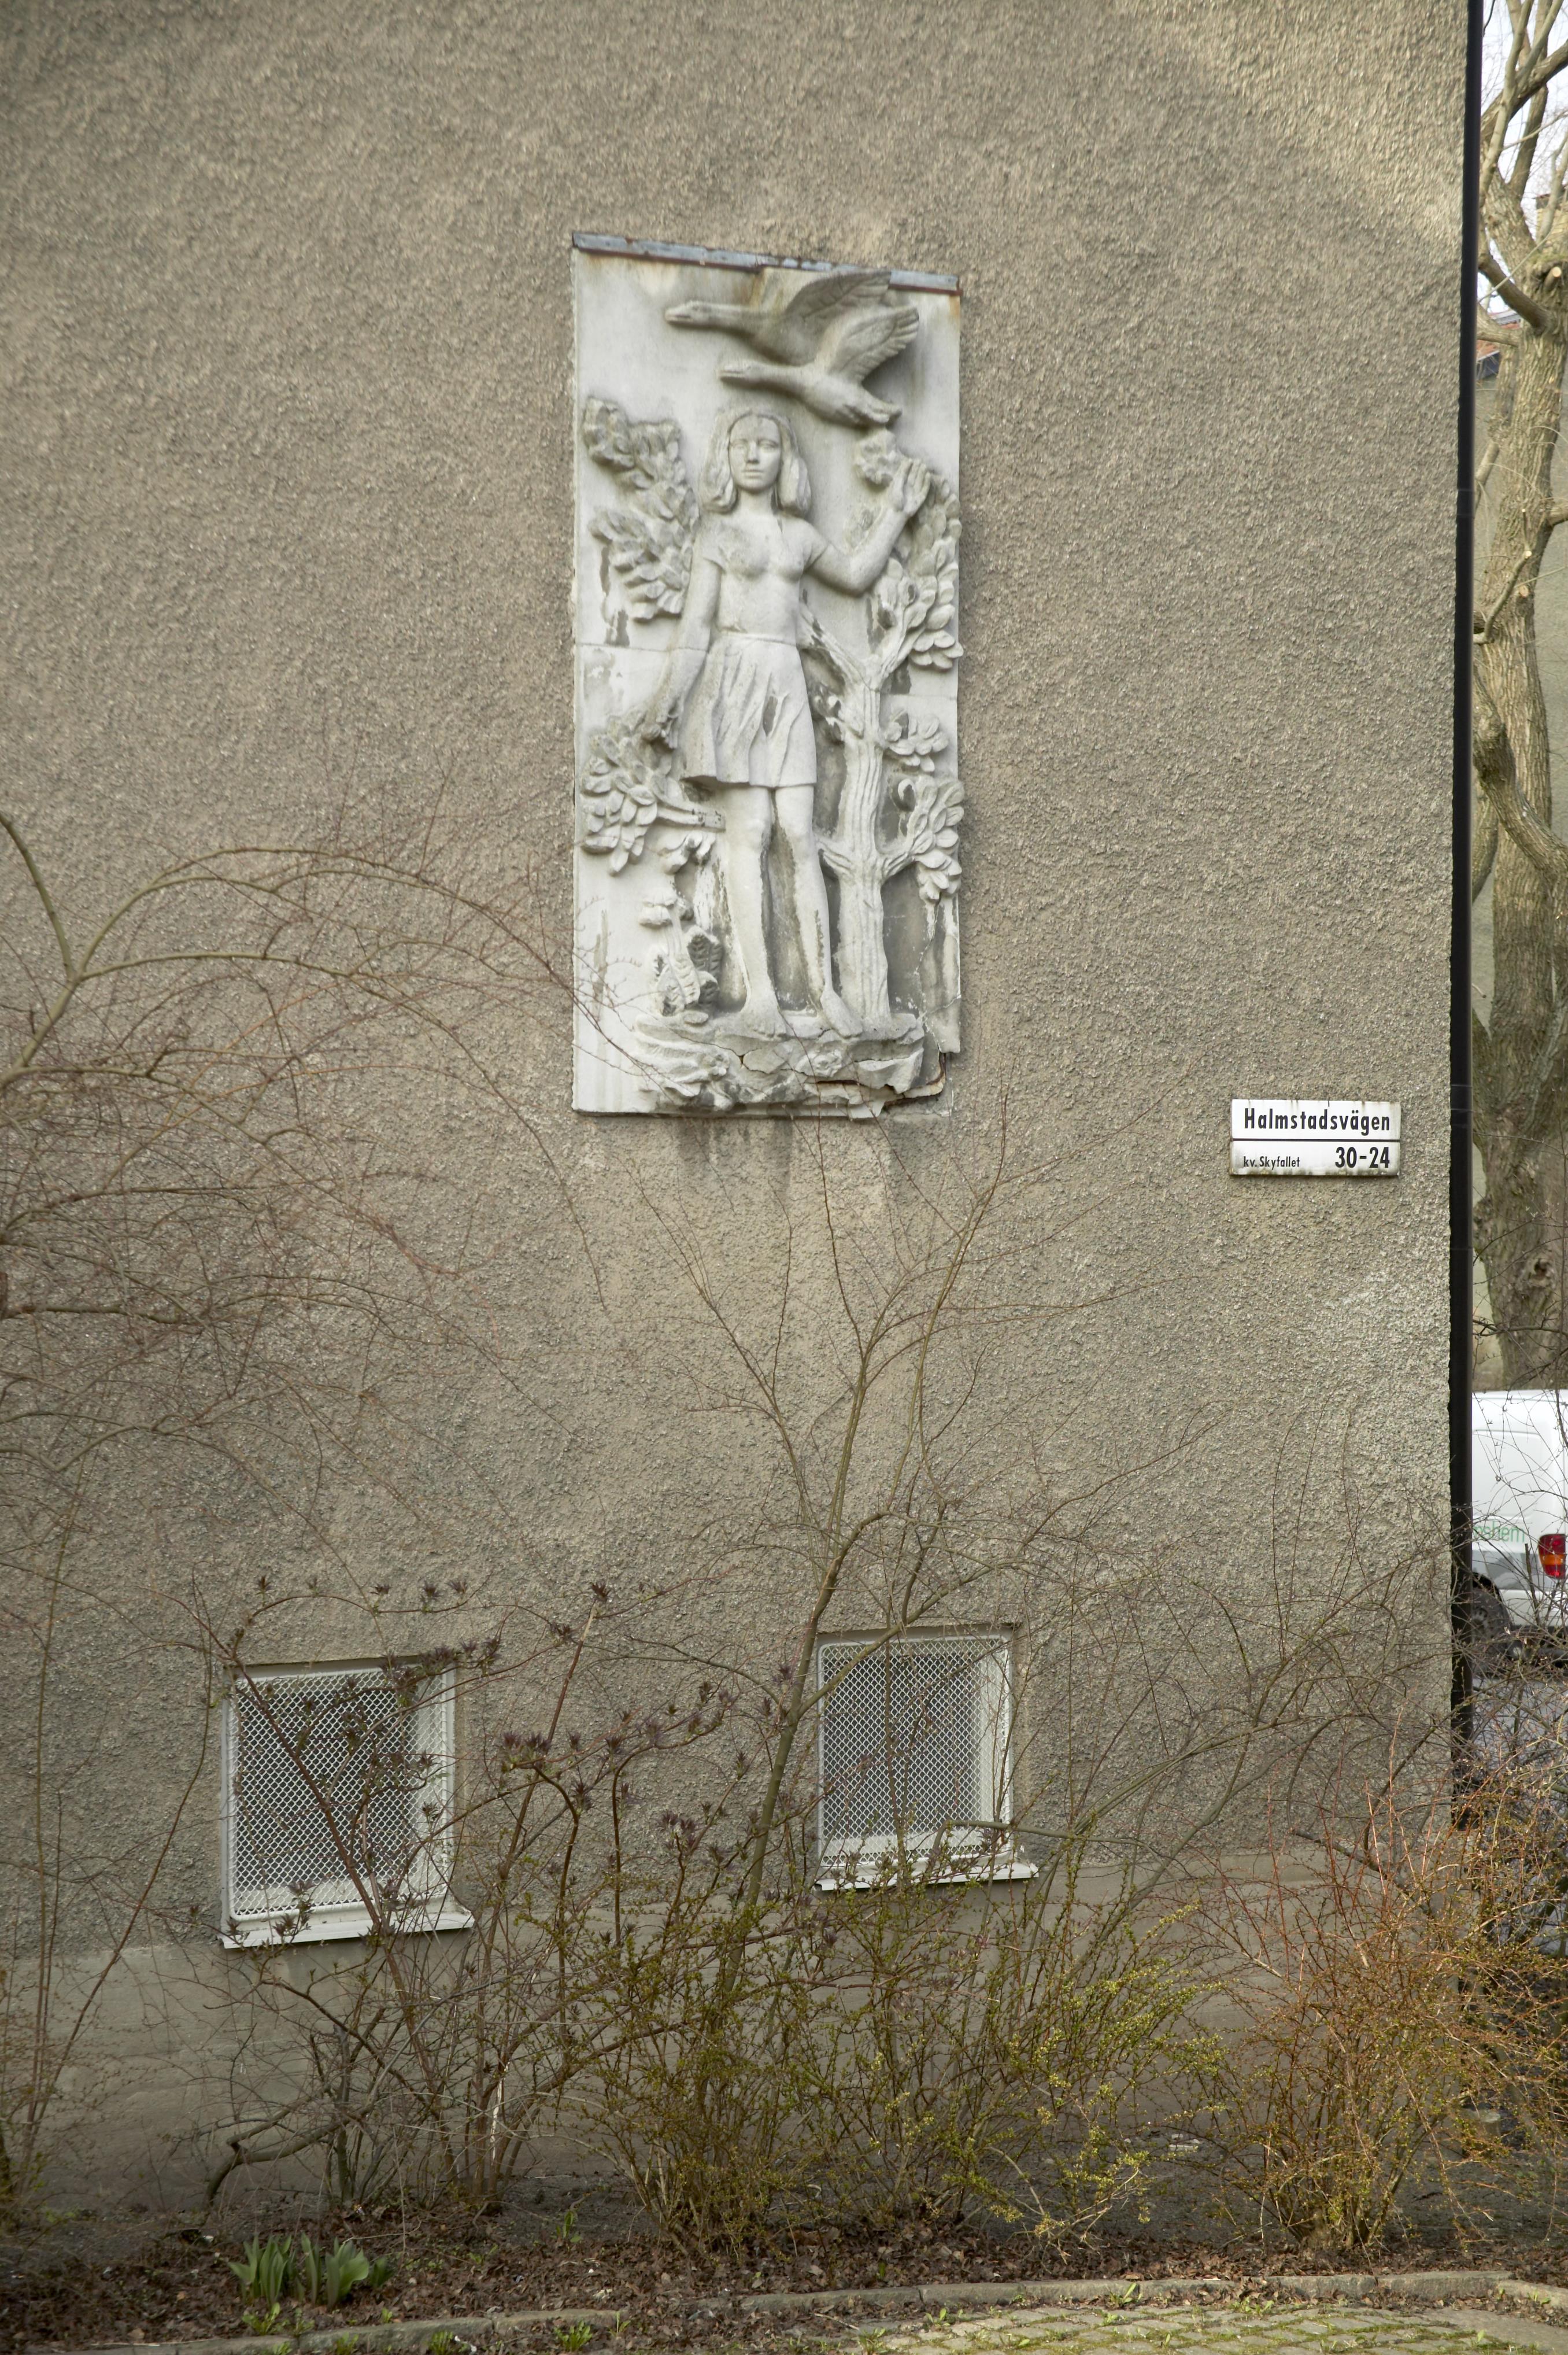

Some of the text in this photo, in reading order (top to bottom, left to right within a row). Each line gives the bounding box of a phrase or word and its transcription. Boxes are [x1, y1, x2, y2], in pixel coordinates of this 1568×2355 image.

[1244, 1108, 1390, 1136] Halmstadsvägen
[1259, 1156, 1300, 1171] Skyfallet
[1334, 1146, 1390, 1169] 30-24
